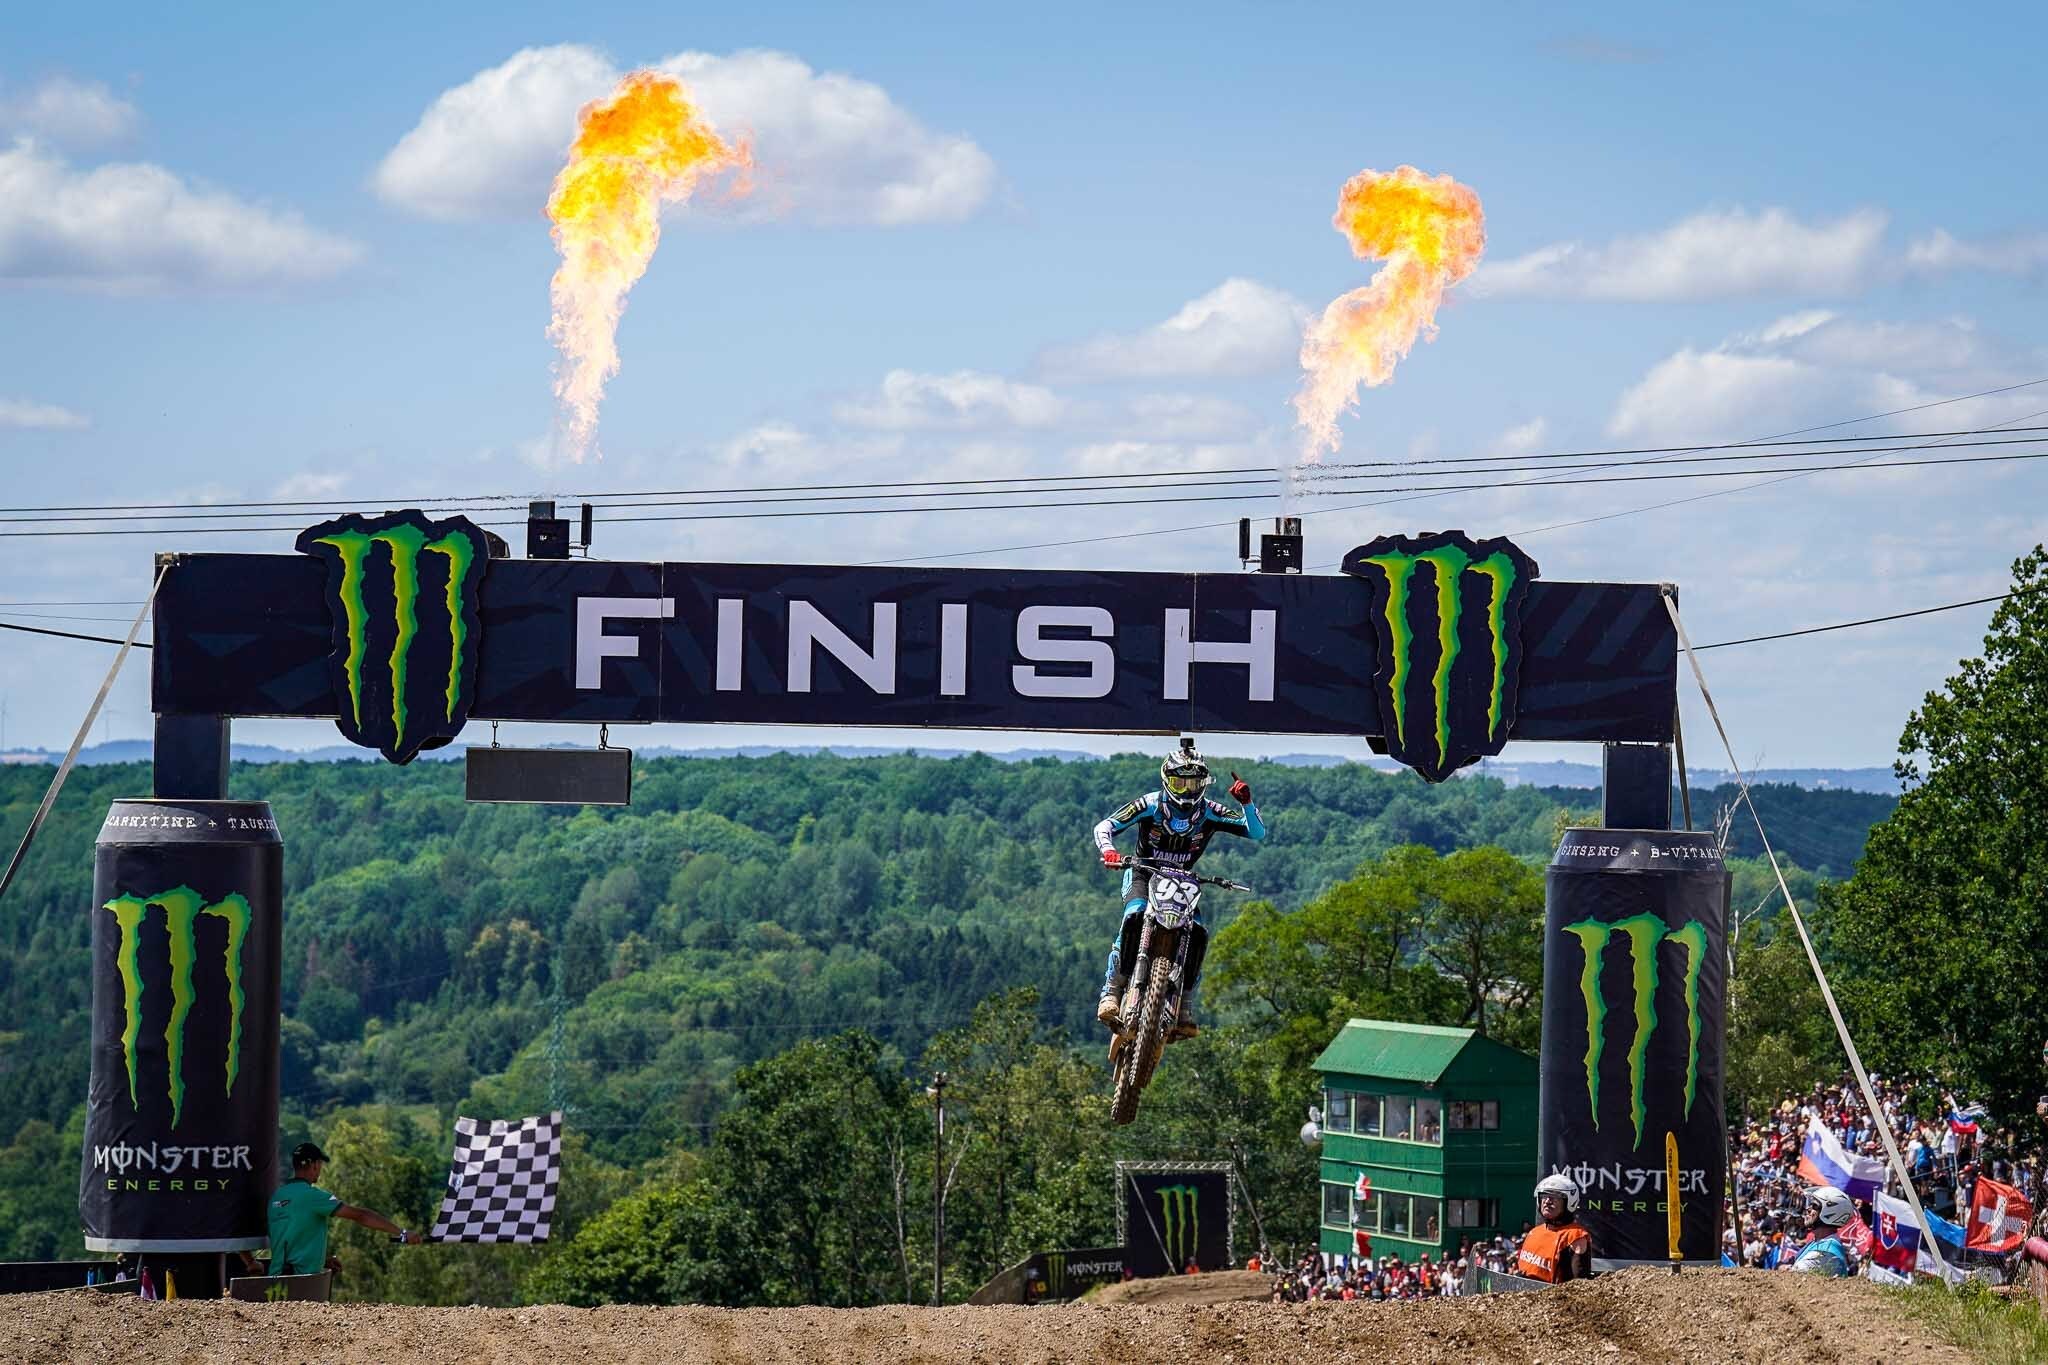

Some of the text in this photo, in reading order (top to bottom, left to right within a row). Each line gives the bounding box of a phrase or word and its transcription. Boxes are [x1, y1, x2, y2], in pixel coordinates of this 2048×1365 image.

[575, 597, 1277, 702] FINISH
[1152, 849, 1192, 863] YAMAHA
[1561, 845, 1620, 857] GINSENG
[1154, 877, 1199, 906] 93
[93, 1140, 253, 1175] MONSTER
[107, 1179, 232, 1191] ENERGY
[1588, 1199, 1689, 1213] NERGY
[1066, 1259, 1124, 1276] MONSTER
